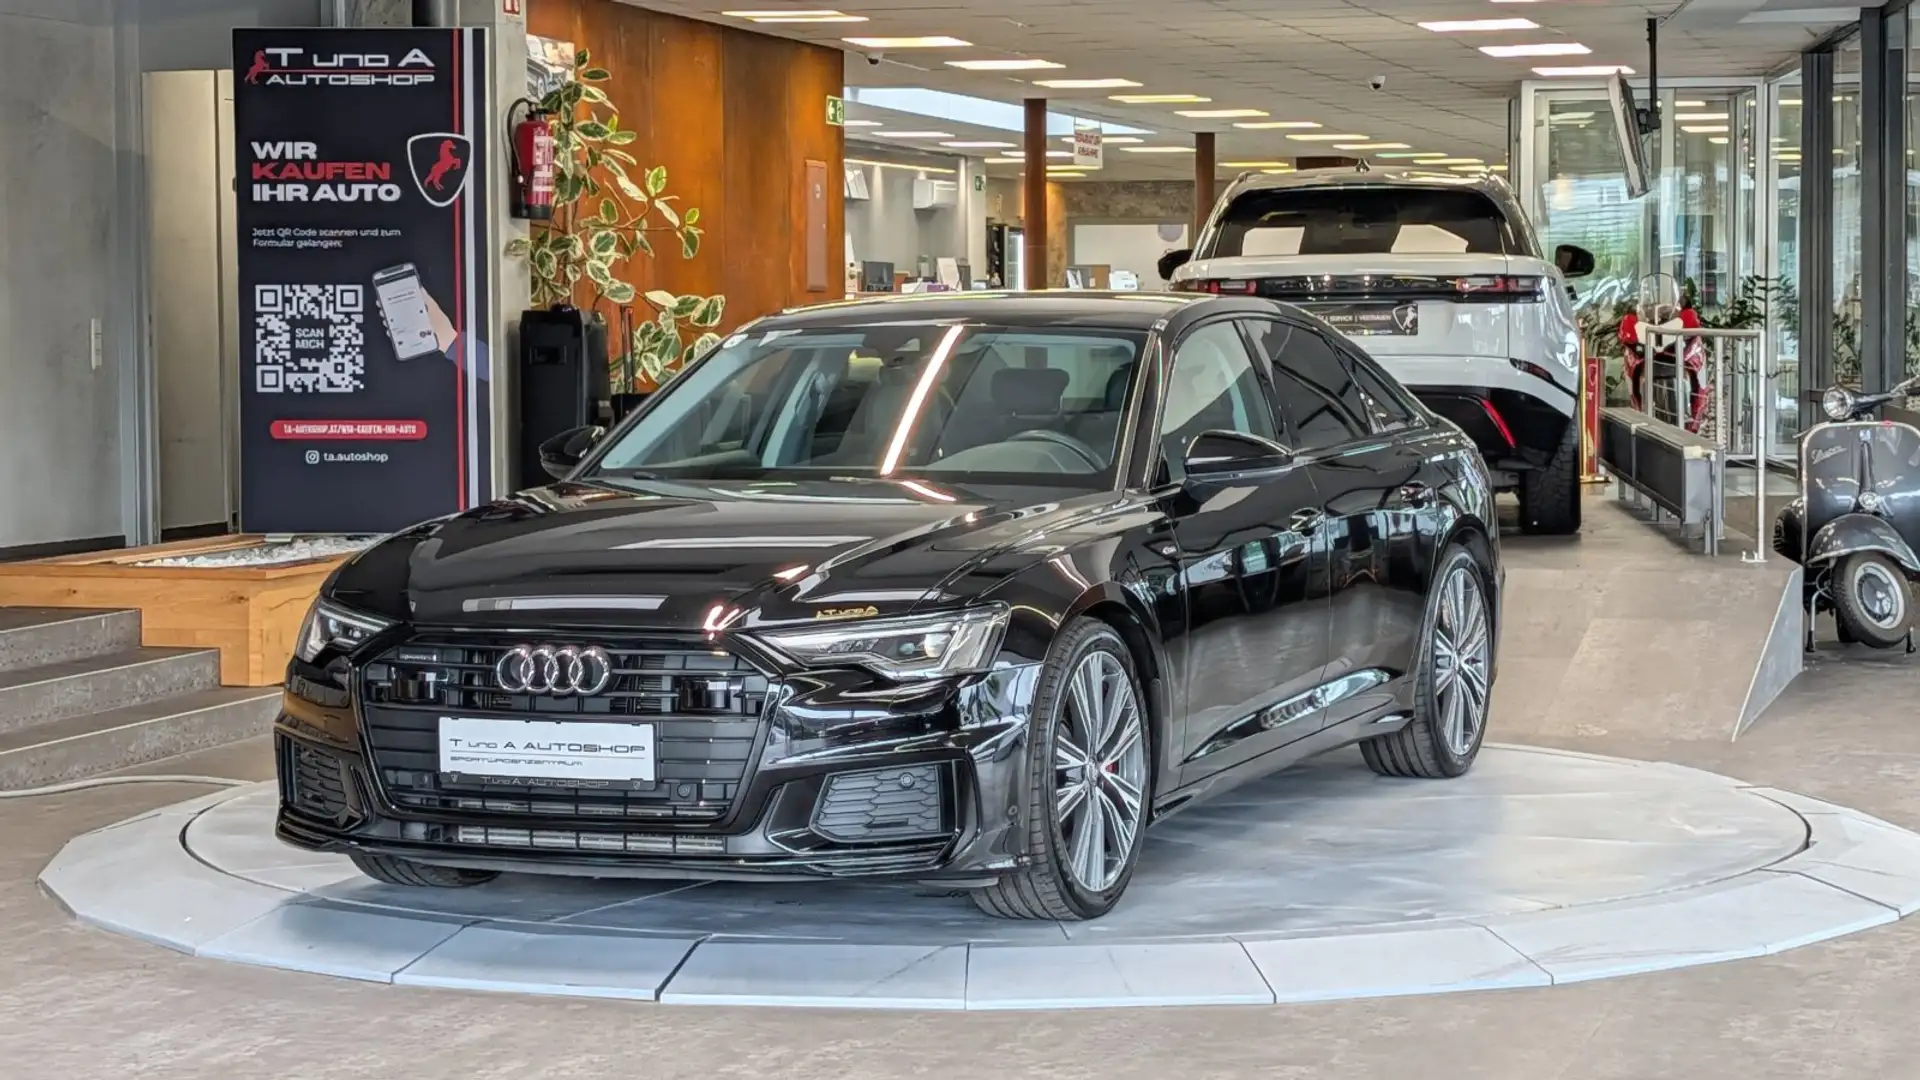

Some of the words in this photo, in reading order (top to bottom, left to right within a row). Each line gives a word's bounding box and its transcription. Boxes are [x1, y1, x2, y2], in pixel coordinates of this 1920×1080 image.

[266, 48, 303, 67] T
[397, 48, 435, 67] A
[266, 74, 435, 85] AUTOSHOP
[251, 141, 317, 159] WIR
[252, 162, 391, 180] KAUFEN
[252, 183, 309, 201] IHR
[312, 183, 401, 201] AUTO
[252, 228, 276, 237] Jetzt
[276, 228, 291, 237] QR
[292, 228, 317, 237] Code
[319, 228, 358, 237] scannen
[359, 228, 378, 237] und
[380, 229, 401, 237] zum
[253, 238, 294, 248] Formular
[295, 327, 324, 338] SCAN
[295, 338, 324, 349] MICH
[323, 452, 389, 463] ta.autoshop
[448, 738, 463, 748] T
[503, 741, 516, 749] A
[523, 742, 646, 754] AUTOSHOP
